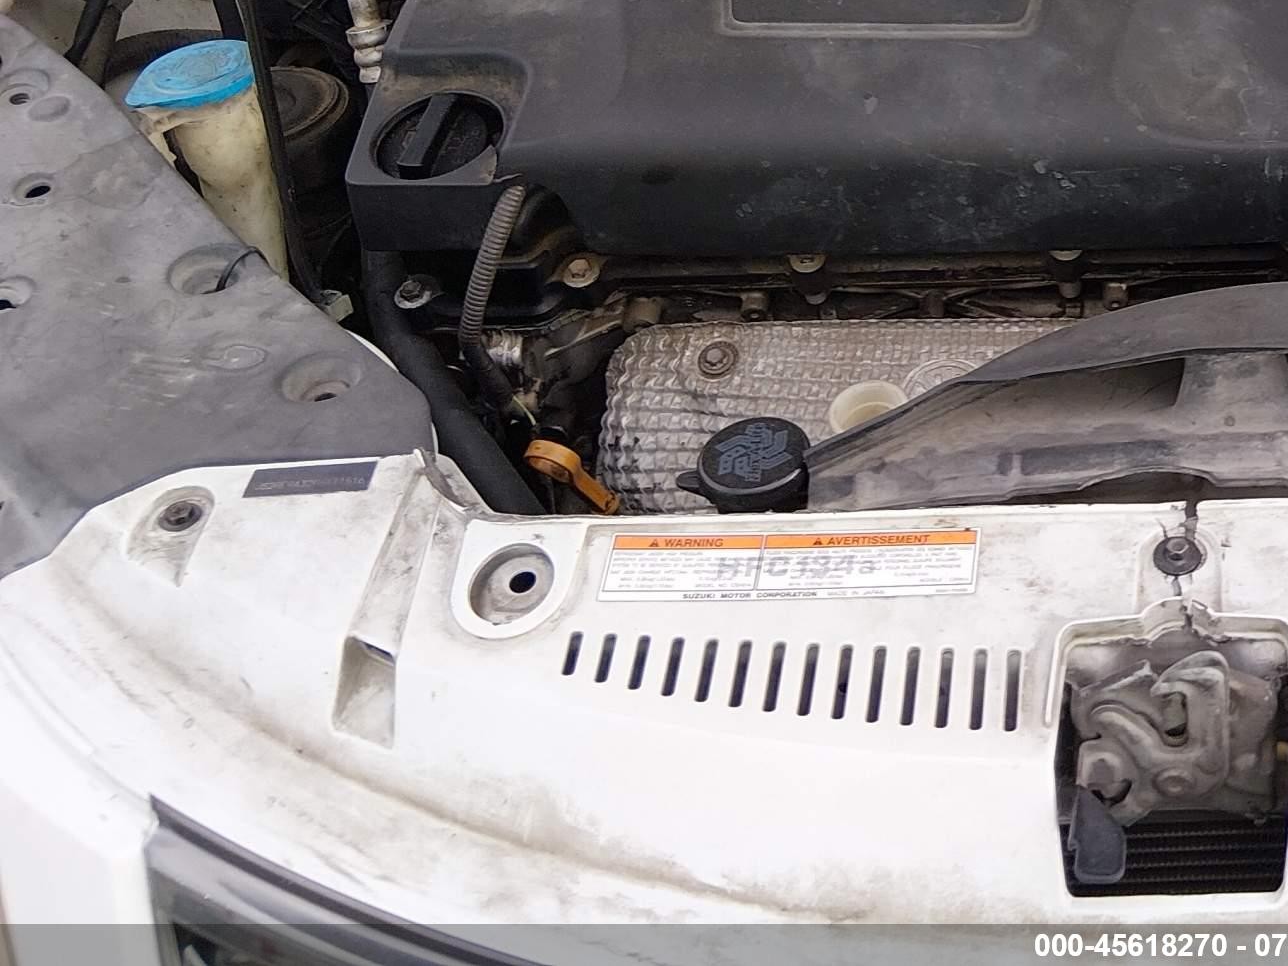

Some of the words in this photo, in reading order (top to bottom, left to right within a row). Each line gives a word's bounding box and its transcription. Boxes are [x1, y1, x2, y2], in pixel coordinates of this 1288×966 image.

[664, 537, 724, 548] WARNING
[826, 535, 930, 546] AVERTISSEMENT
[756, 590, 817, 598] CORPORATION
